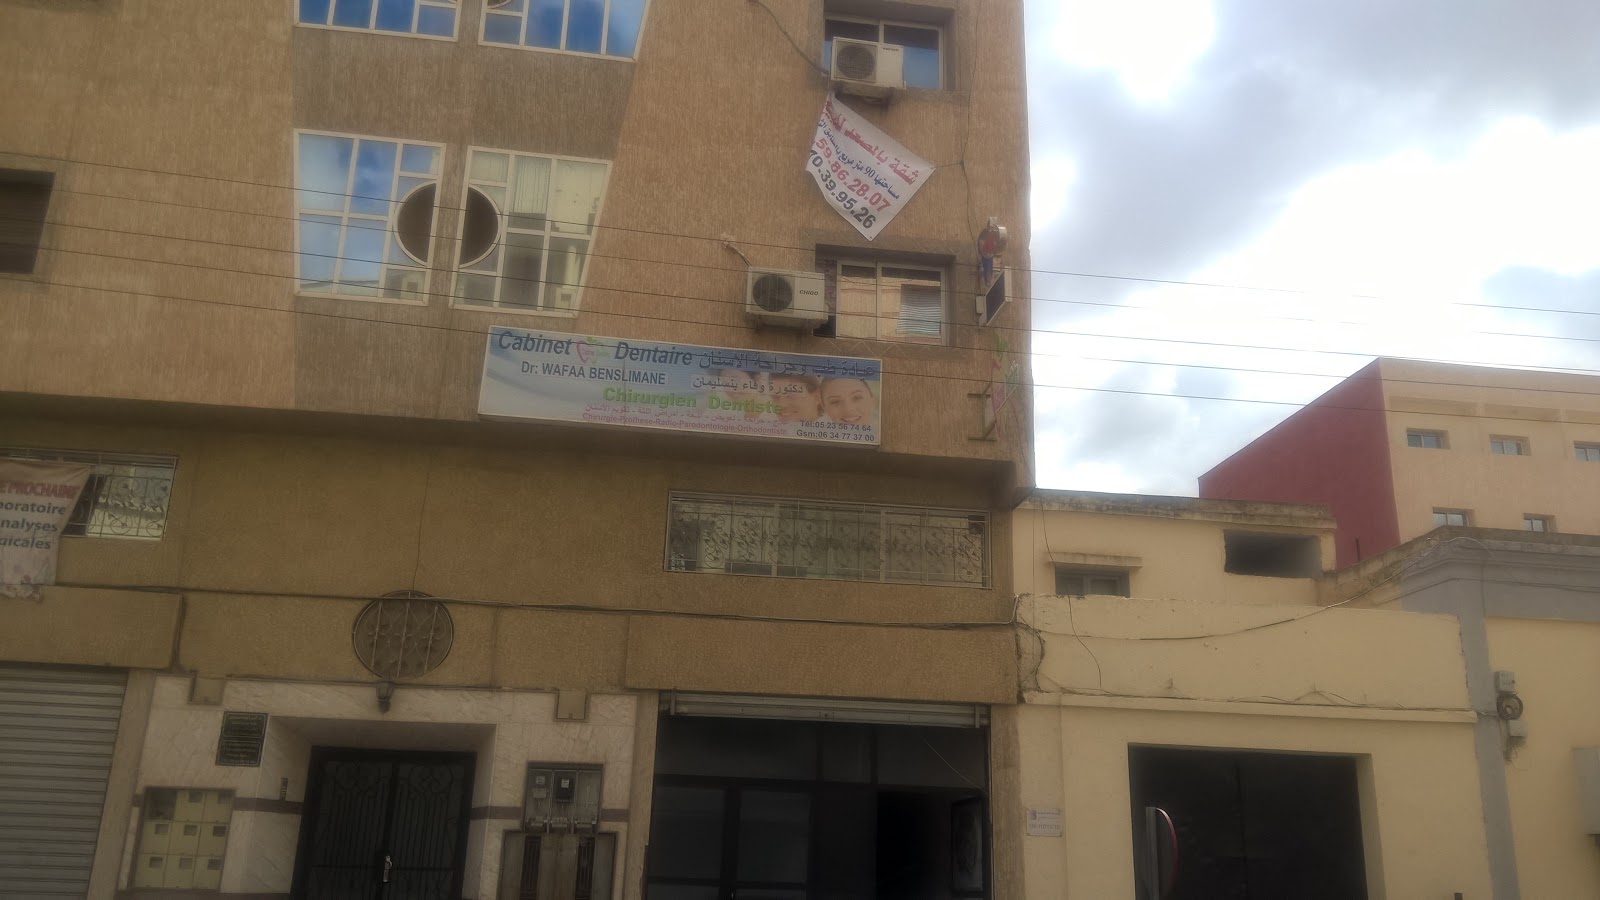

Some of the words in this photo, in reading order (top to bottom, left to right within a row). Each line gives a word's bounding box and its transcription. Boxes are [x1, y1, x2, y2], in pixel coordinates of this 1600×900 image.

[865, 166, 876, 178] 90
[889, 157, 919, 186] شقة
[498, 330, 573, 356] Cabinet
[614, 341, 693, 366] Dentaire
[521, 361, 538, 375] Dr:
[542, 362, 586, 379] WAFAA
[589, 367, 666, 385] BENSLIMANE
[753, 351, 807, 377] وجراحة
[812, 359, 837, 378] طب
[842, 360, 875, 381] عيادة
[692, 376, 739, 391] بنسليمان
[742, 379, 766, 394] وفاء
[769, 381, 804, 395] دكتورة
[603, 387, 697, 409] Chirurgien
[708, 394, 784, 415] Dentiste
[796, 429, 828, 439] Gsm:06
[829, 431, 839, 440] 34
[841, 432, 851, 440] 77
[853, 433, 863, 441] 37
[864, 434, 875, 442] 00
[827, 421, 837, 430] 23
[838, 422, 848, 430] 56
[850, 423, 860, 431] 74
[862, 424, 872, 432] 64
